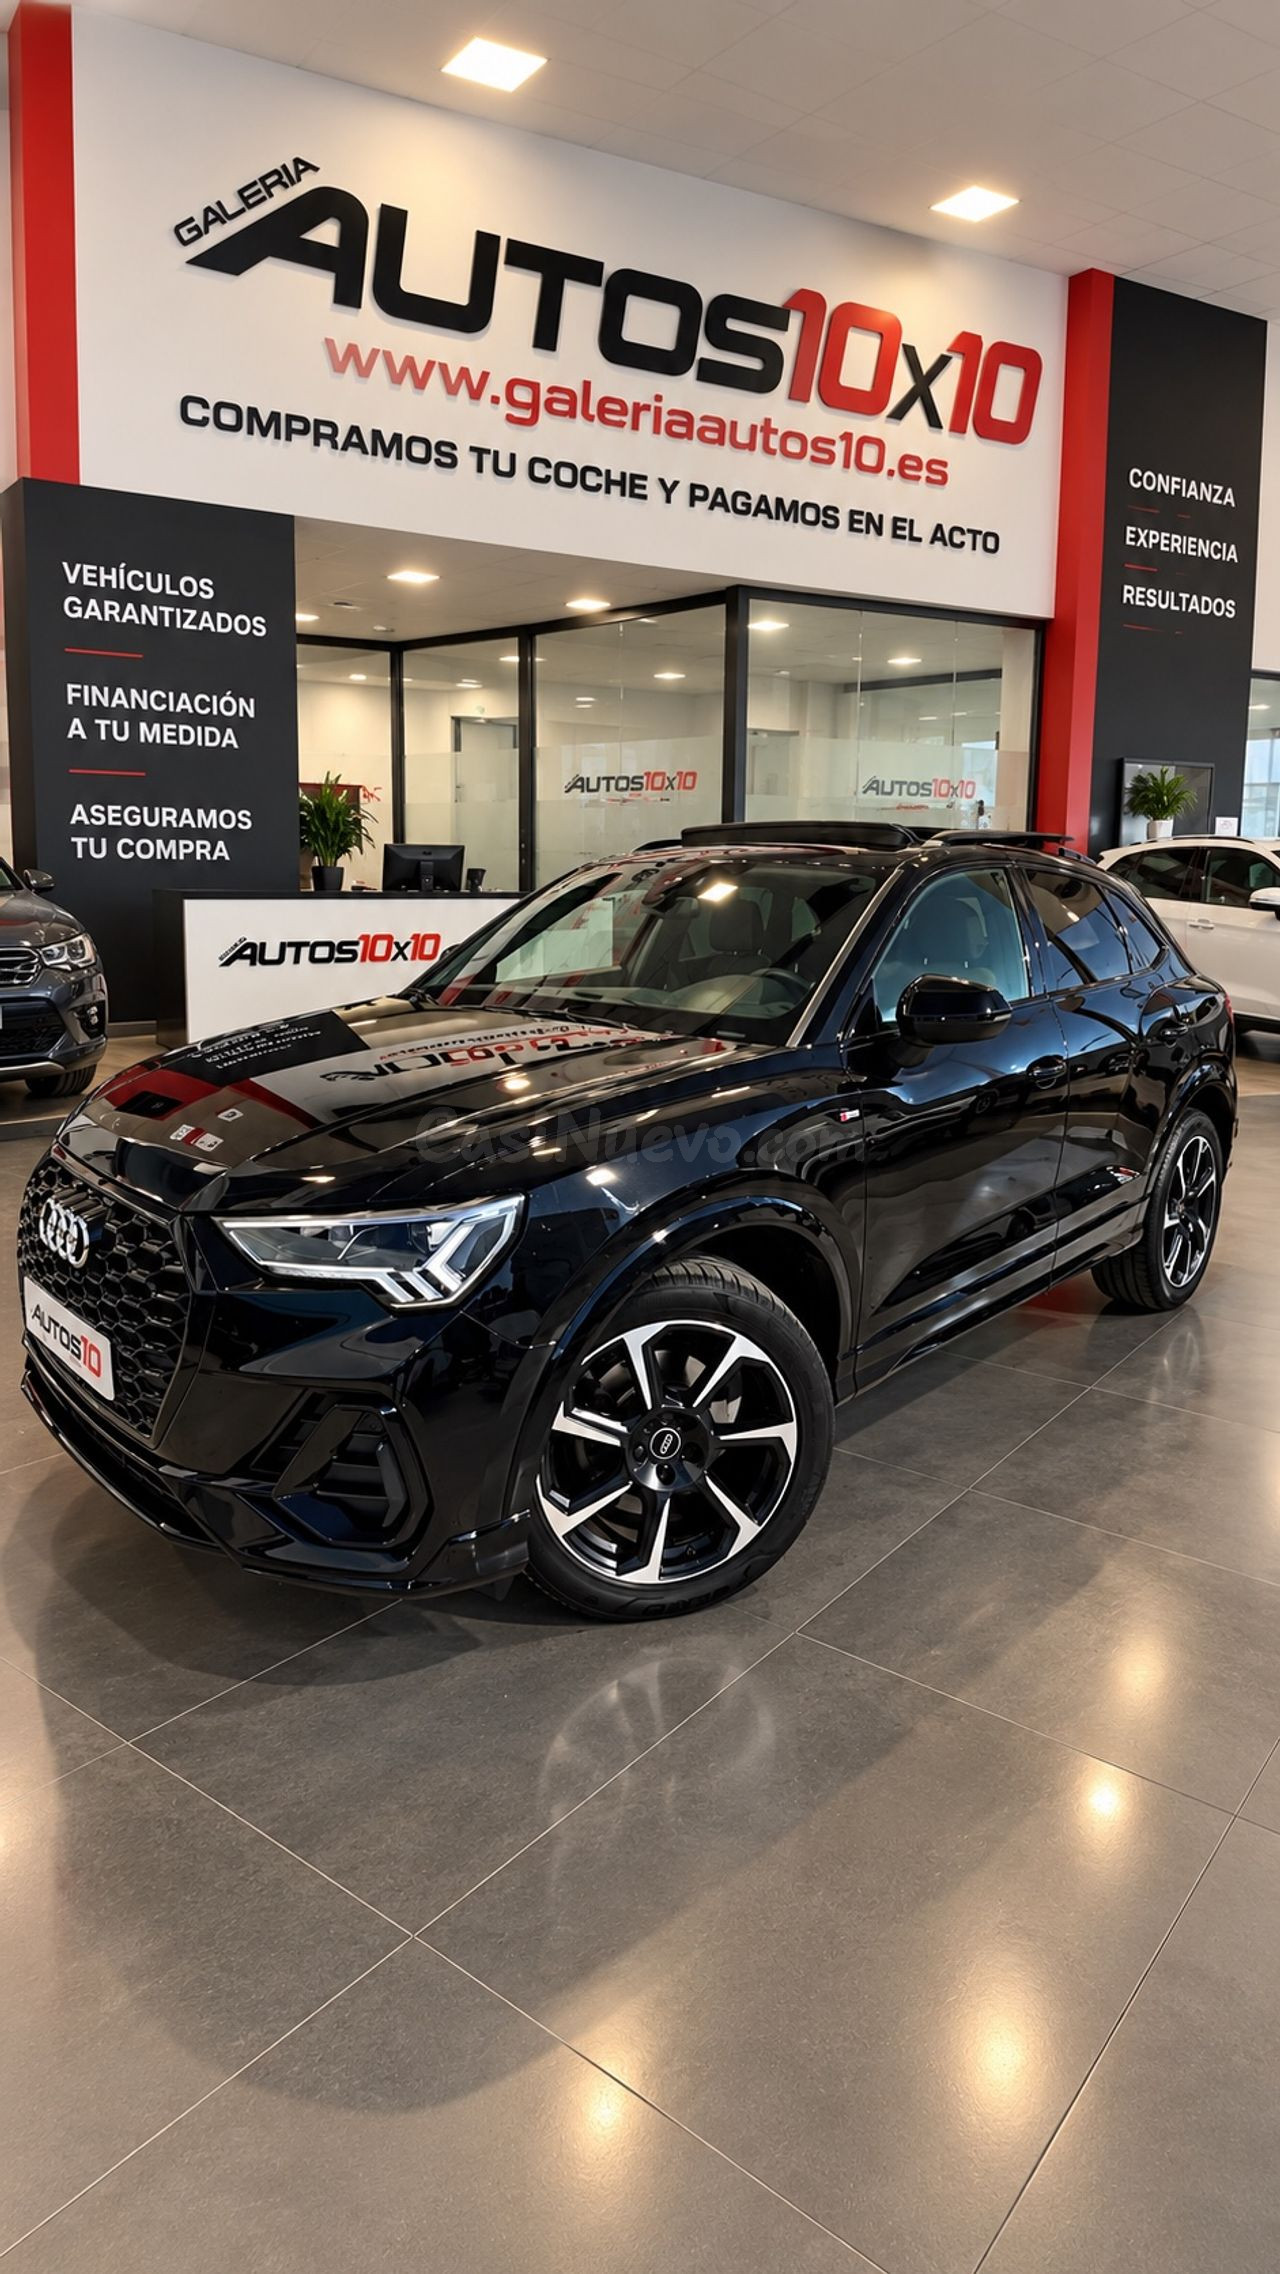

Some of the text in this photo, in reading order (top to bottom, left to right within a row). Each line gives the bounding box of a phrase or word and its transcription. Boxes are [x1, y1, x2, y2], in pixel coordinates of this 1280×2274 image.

[173, 156, 320, 247] GALERIA
[324, 337, 949, 486] www.galeriaautos10.es
[180, 395, 1001, 555] COMPRAMOS TU COCHE Y PAGAMOS EN EL ACTO
[1128, 467, 1236, 507] CONFIANZA
[1125, 525, 1239, 563] EXPERIENCIA
[62, 562, 215, 599] VEHÍCULOS
[62, 596, 268, 637] GARANTIZADOS
[1122, 584, 1237, 619] RESULTADOS
[66, 683, 256, 718] FINANCIACIÓN
[66, 717, 239, 749] A TU MEDIDA
[70, 803, 253, 830] ASEGURAMOS
[71, 837, 230, 861] TU COMPRA
[31, 1303, 103, 1378] AUTOS10
